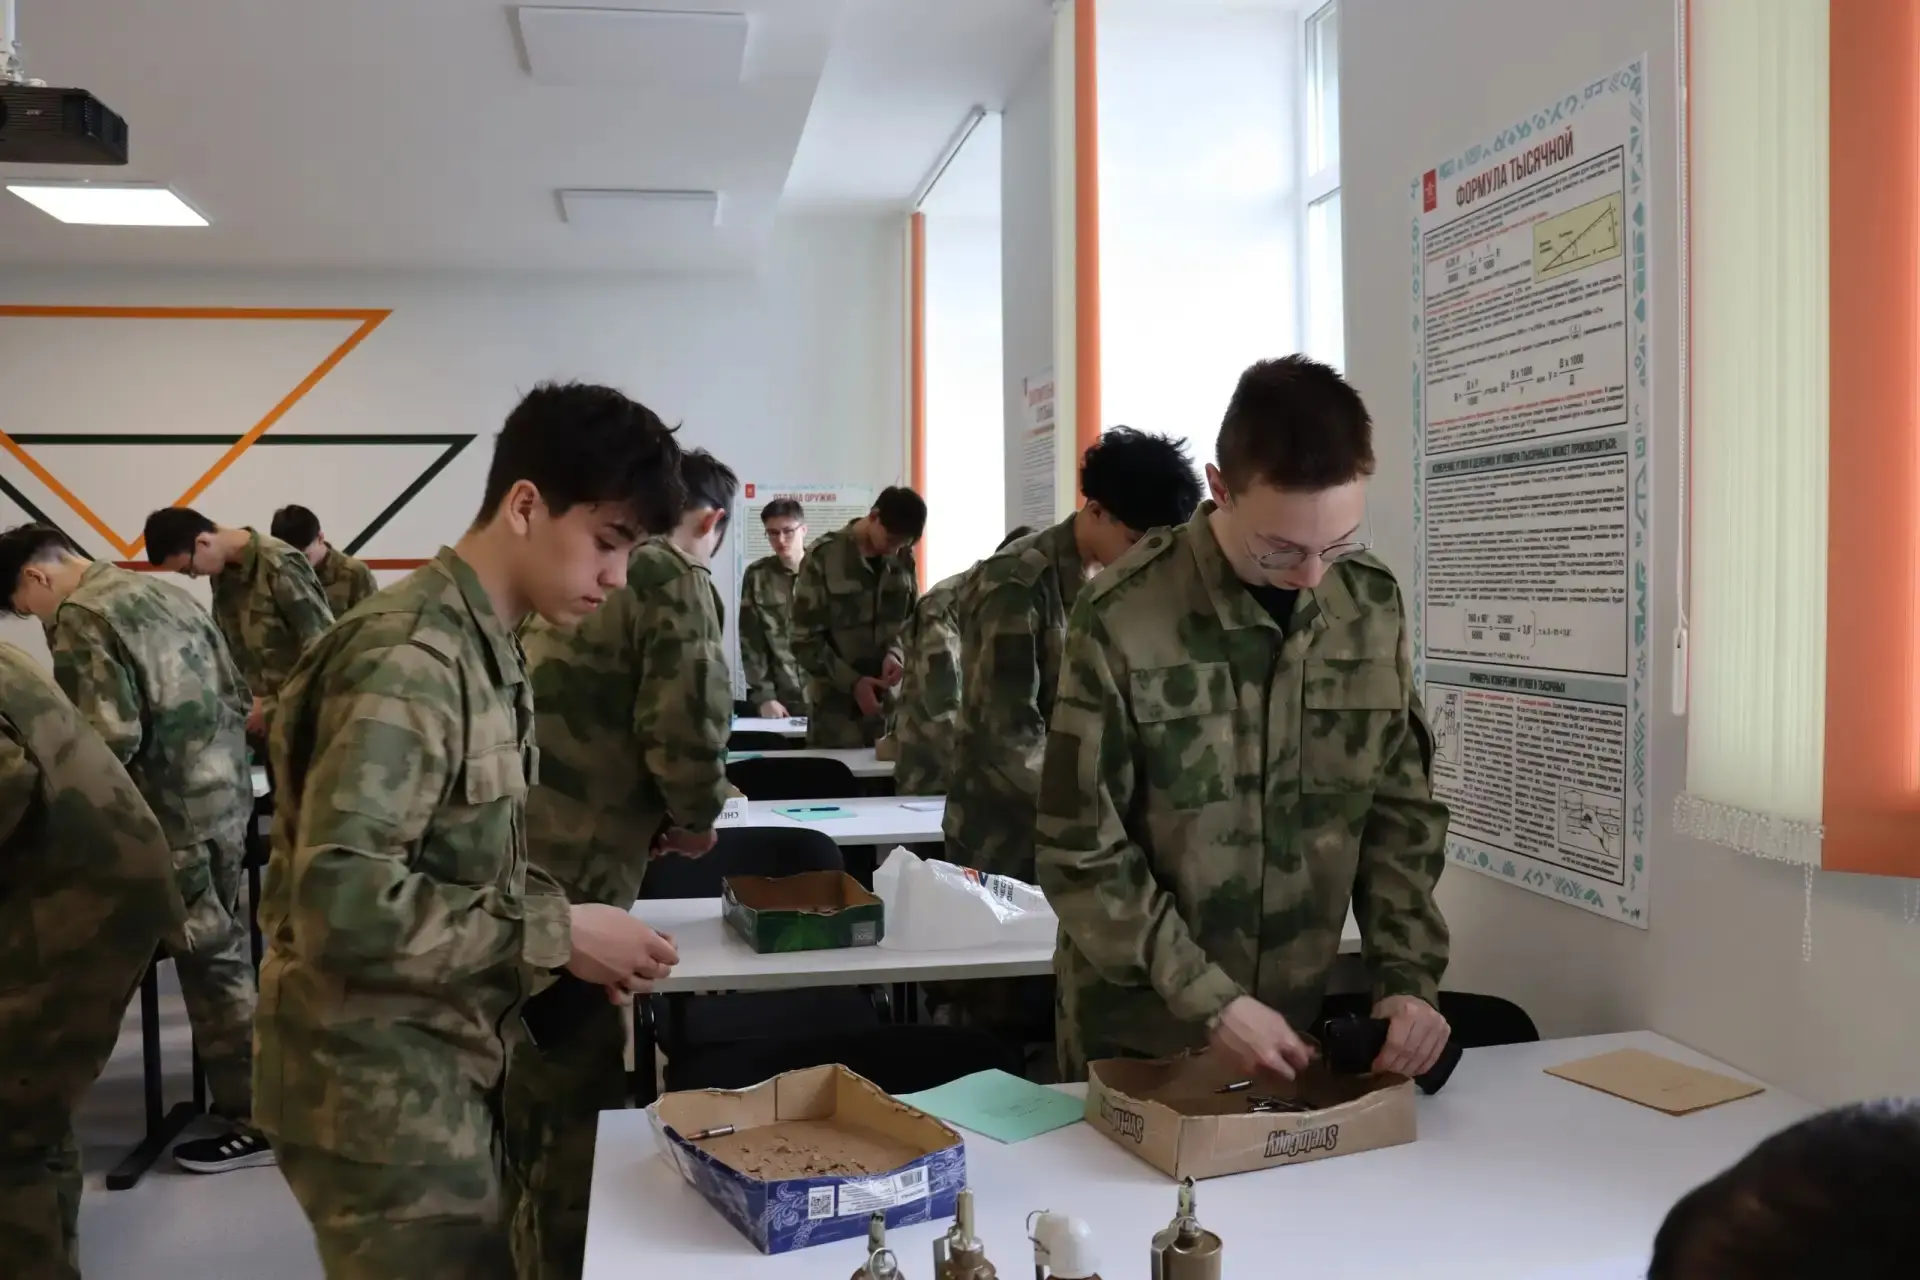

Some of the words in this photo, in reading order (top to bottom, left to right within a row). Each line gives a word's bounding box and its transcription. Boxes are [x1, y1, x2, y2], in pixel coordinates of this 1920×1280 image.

[1456, 163, 1508, 207] ФОРМУЛА
[1509, 125, 1574, 183] ТЫСЯЧНОЙ
[1264, 1124, 1339, 1158] SvetoCopy
